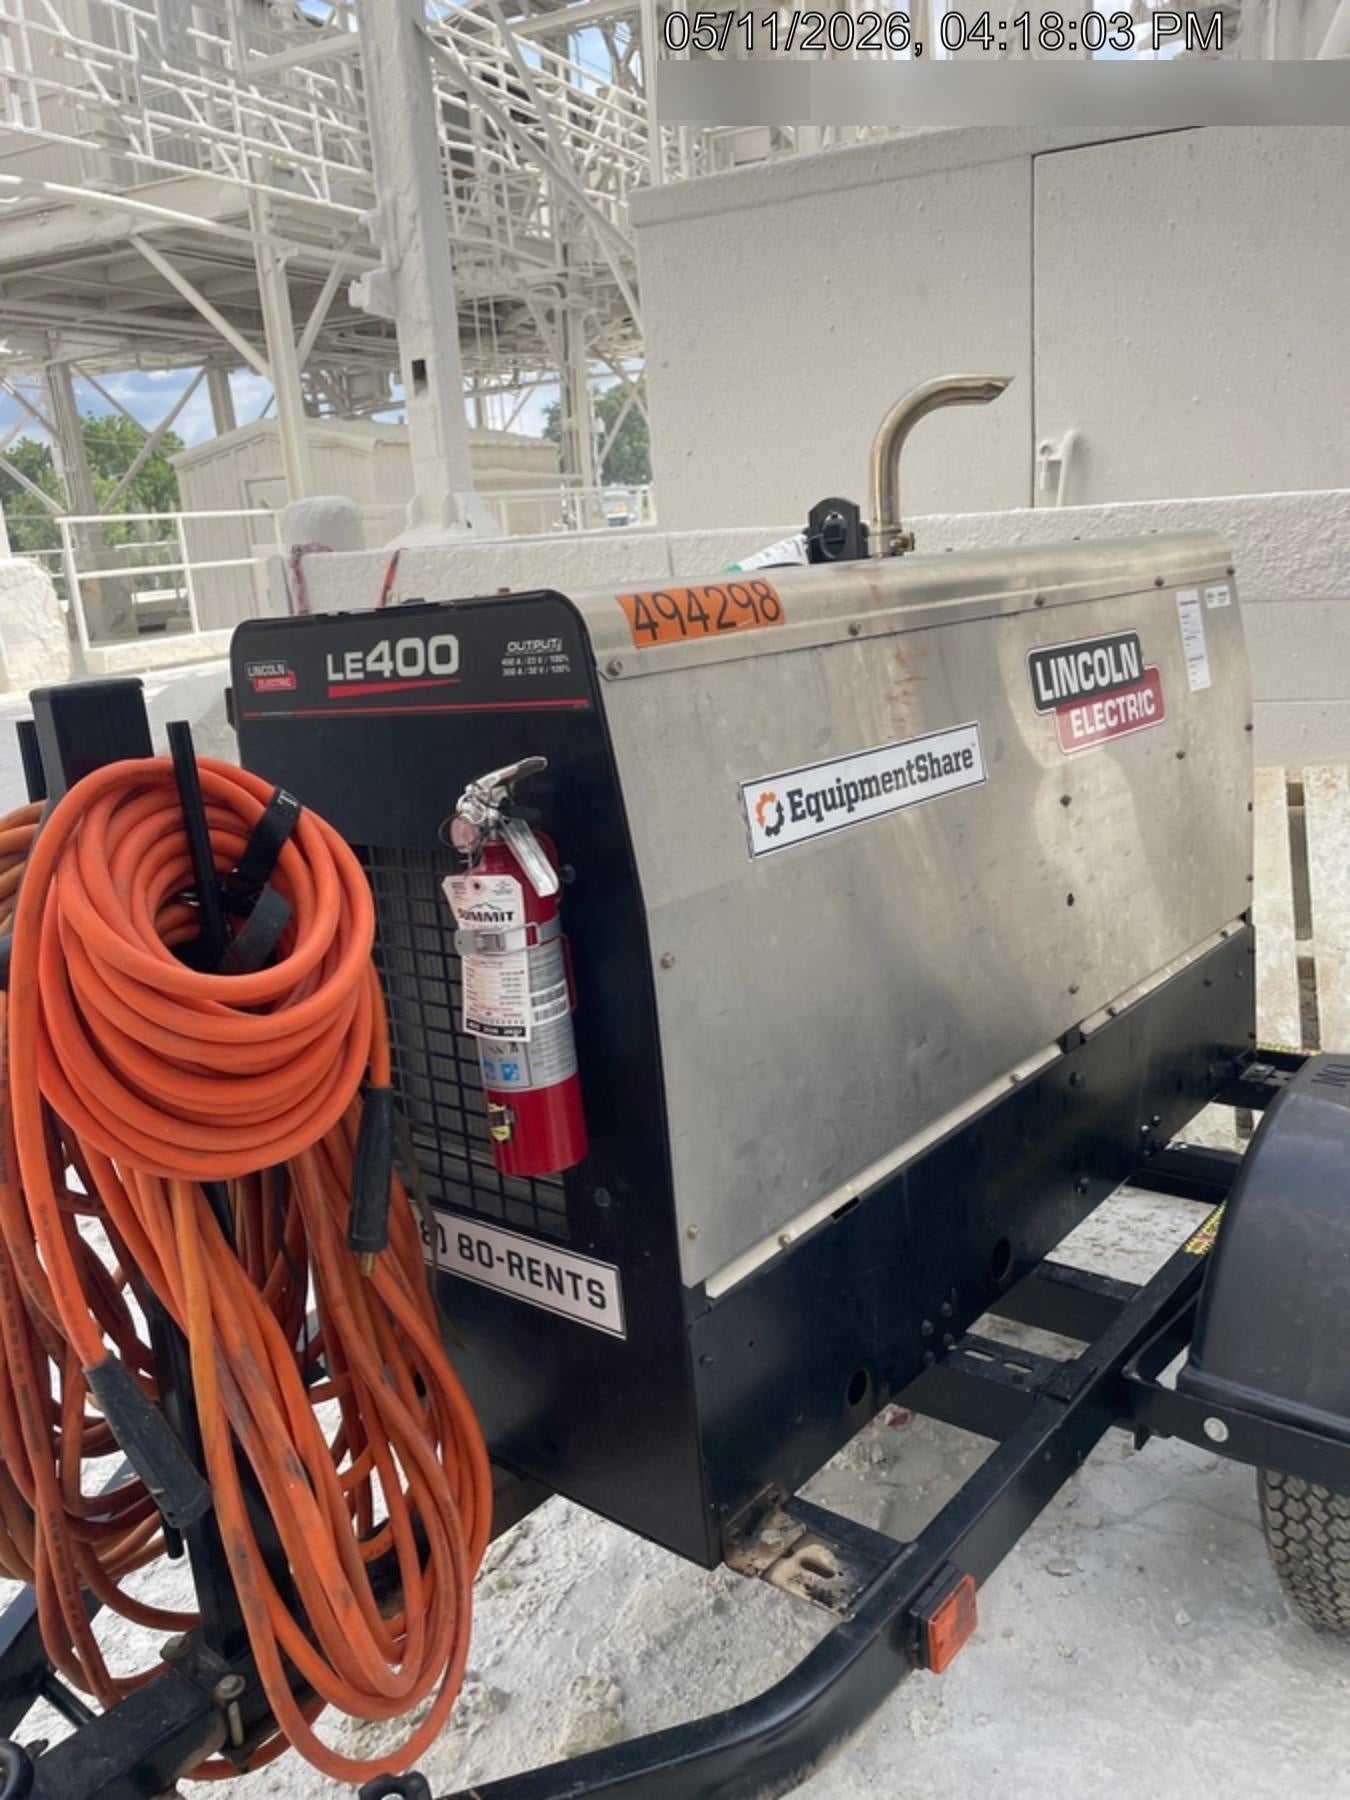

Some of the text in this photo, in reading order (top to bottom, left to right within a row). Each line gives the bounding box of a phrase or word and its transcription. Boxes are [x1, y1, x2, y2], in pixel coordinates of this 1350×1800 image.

[634, 580, 781, 640] 494298
[247, 664, 286, 677] LINCOLN
[326, 634, 460, 682] LE400
[1035, 641, 1140, 702] LINCOLN
[1069, 688, 1156, 739] ELECTRIC
[786, 746, 975, 823] EquipmentShare
[457, 907, 514, 923] SUMMIT
[457, 1232, 608, 1311] 80-RENTS
